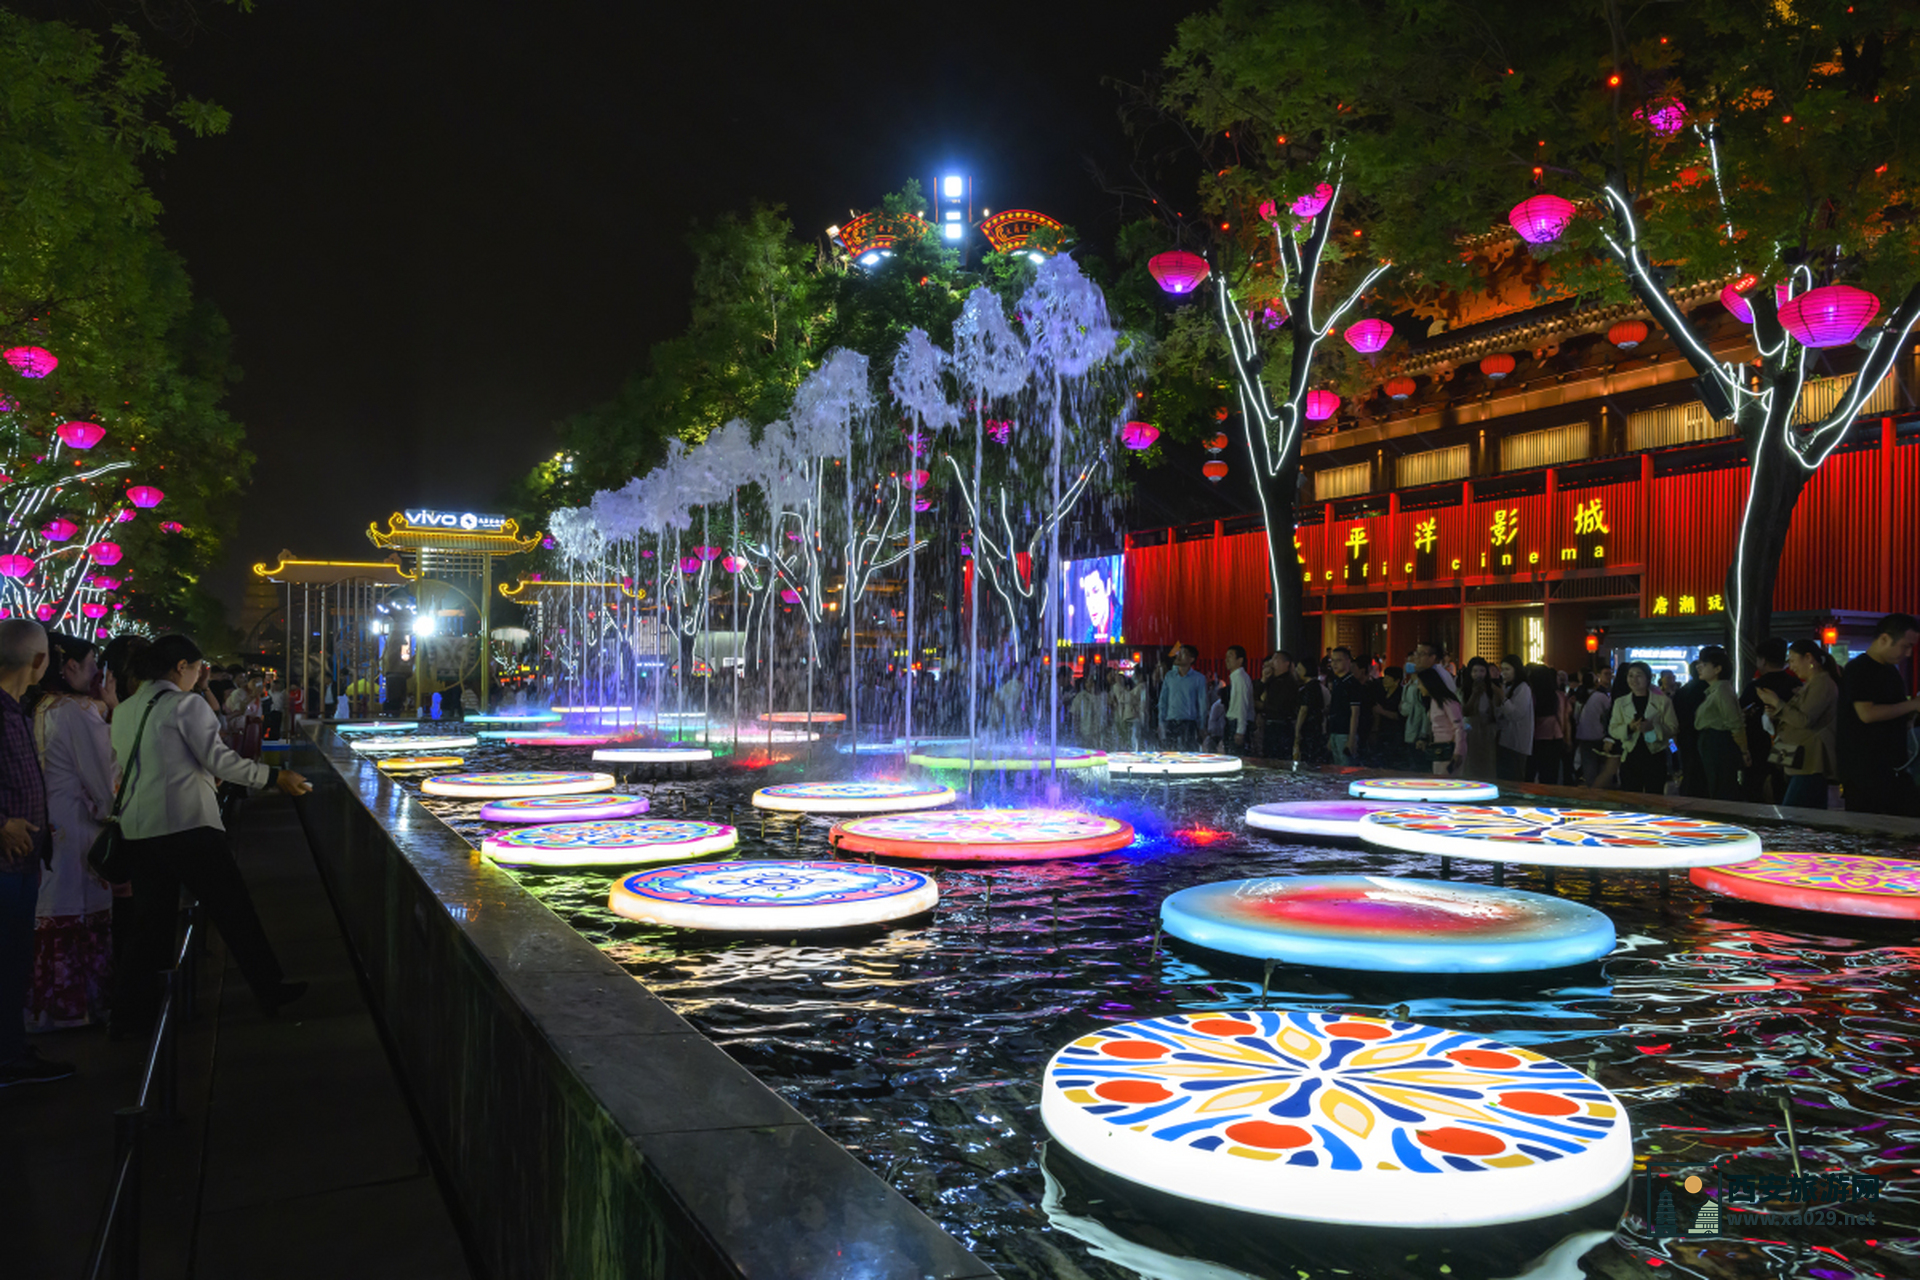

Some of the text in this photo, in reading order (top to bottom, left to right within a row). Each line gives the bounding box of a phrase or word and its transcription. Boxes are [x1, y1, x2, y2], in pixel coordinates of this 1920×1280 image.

[405, 510, 457, 526] vivo
[1303, 545, 1605, 582] acific cinema
